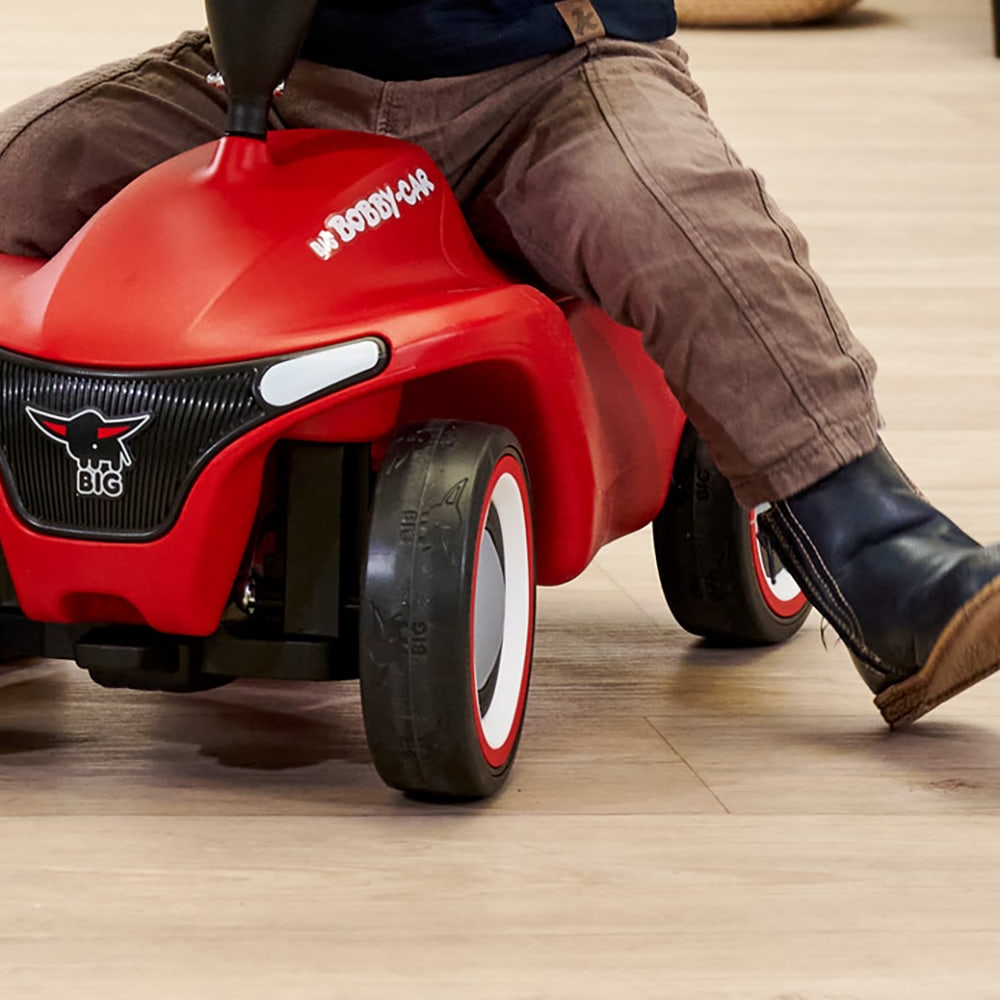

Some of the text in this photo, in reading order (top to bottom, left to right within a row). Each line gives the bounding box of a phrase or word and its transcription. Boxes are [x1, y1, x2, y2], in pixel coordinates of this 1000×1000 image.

[327, 168, 435, 243] BOBBY-CAR
[76, 468, 124, 498] BIG
[411, 621, 428, 655] BIG
